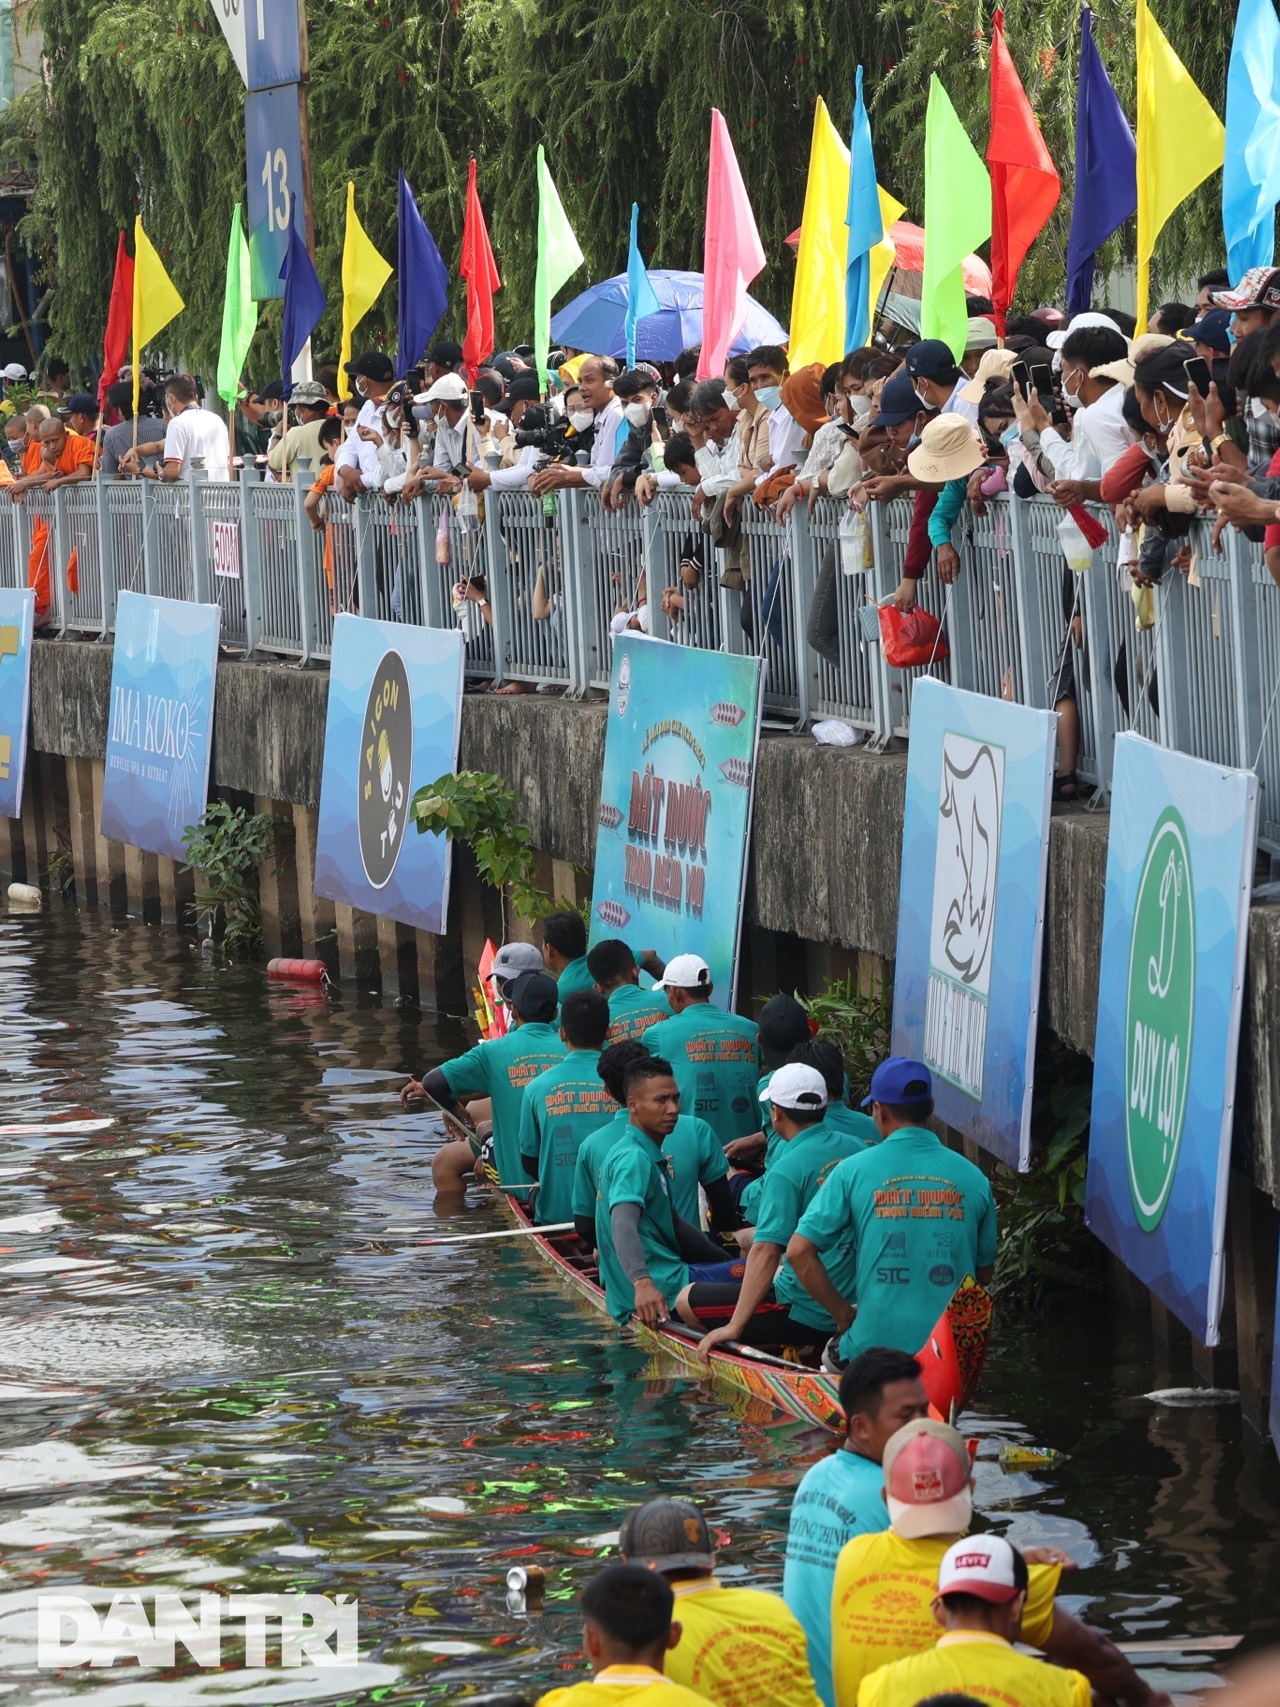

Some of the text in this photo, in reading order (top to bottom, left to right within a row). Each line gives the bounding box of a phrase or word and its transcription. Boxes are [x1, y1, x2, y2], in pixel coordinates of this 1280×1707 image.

[261, 148, 291, 232] 13
[111, 686, 189, 759] IMA KOKO
[364, 680, 399, 800] SAIGON
[695, 1098, 720, 1112] STC
[1131, 1020, 1180, 1165] DUY LỢI
[874, 1186, 913, 1206] ĐẤT
[876, 1267, 910, 1284] STC
